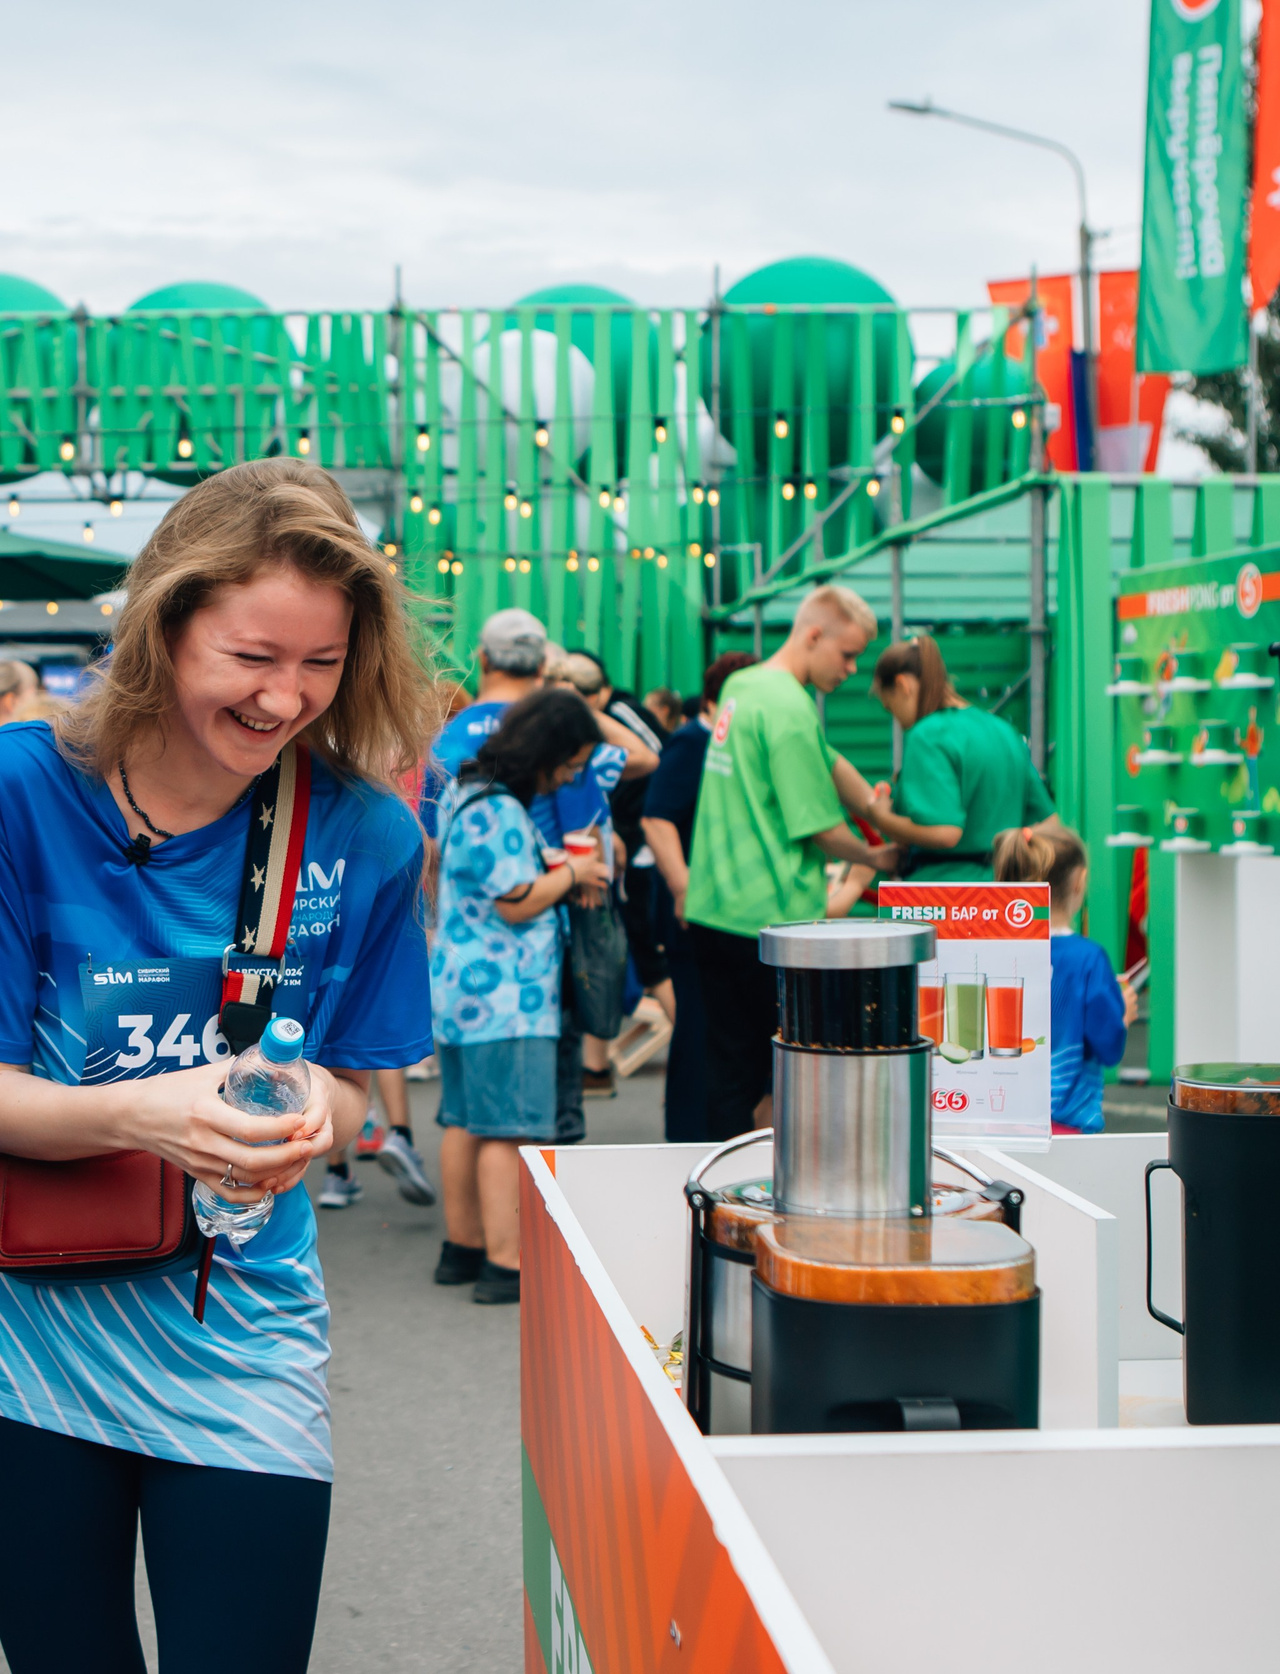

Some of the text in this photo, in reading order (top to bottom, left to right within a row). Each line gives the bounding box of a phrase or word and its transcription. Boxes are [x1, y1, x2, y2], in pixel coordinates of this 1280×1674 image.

[891, 906, 946, 920] FRESH
[951, 906, 978, 920] БАР
[285, 968, 303, 977] 024
